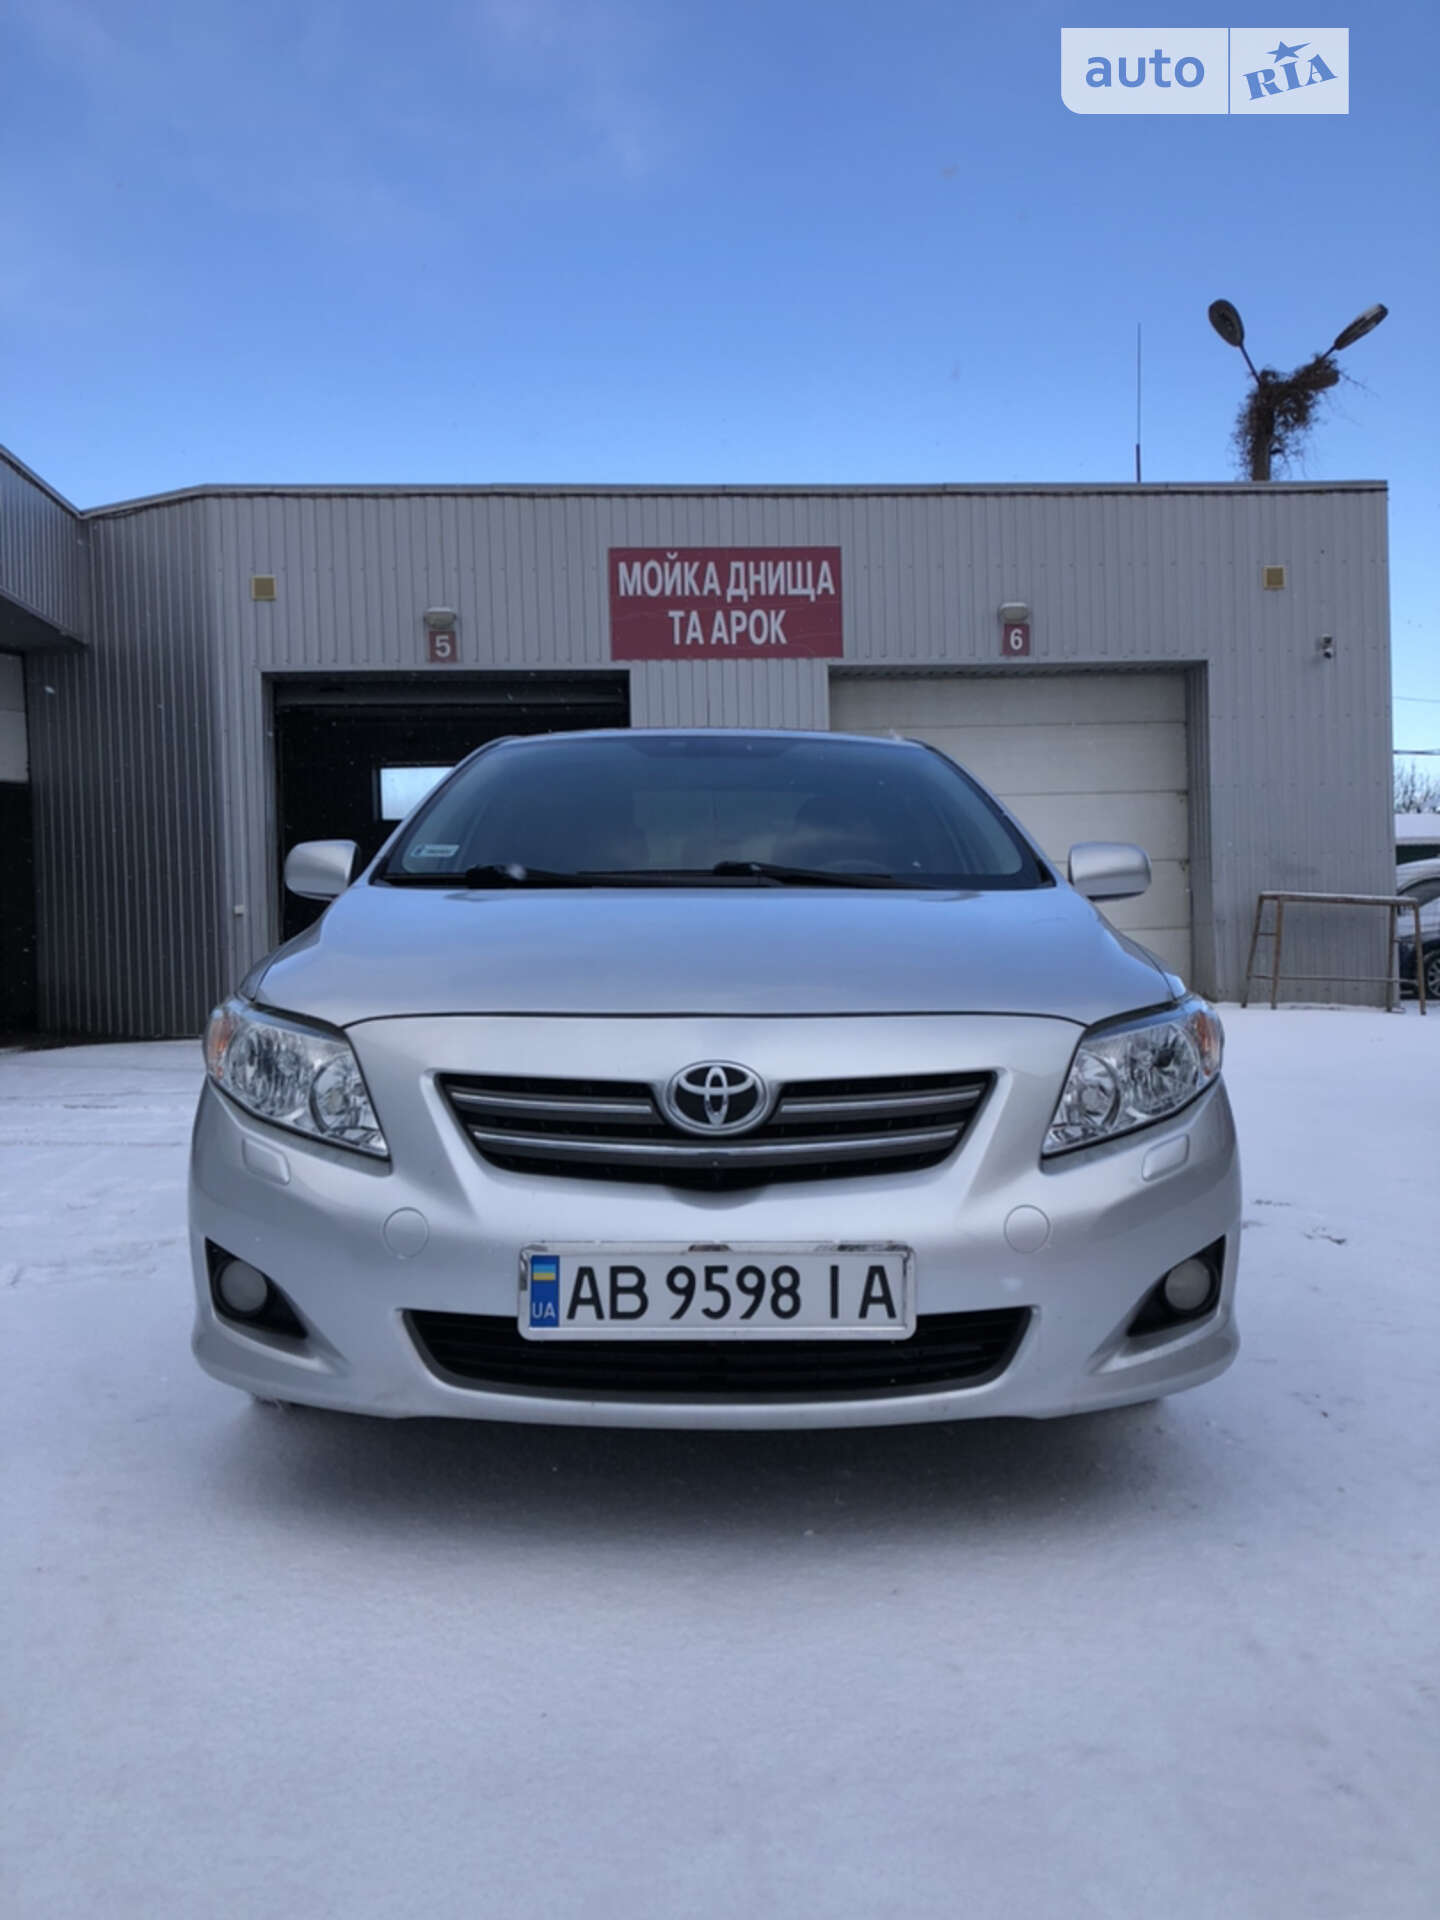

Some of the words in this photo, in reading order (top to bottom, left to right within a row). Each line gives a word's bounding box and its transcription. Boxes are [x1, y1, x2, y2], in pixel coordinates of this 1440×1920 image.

[618, 552, 721, 597] МОЙКА
[726, 560, 836, 603] ДНИЩА
[668, 610, 705, 645] ТА
[710, 609, 788, 645] АРОК
[1009, 628, 1024, 651] 6
[435, 635, 451, 658] 5
[566, 1265, 649, 1320] AB
[666, 1264, 802, 1320] 9598
[829, 1264, 897, 1320] IA
[531, 1301, 556, 1320] UA
